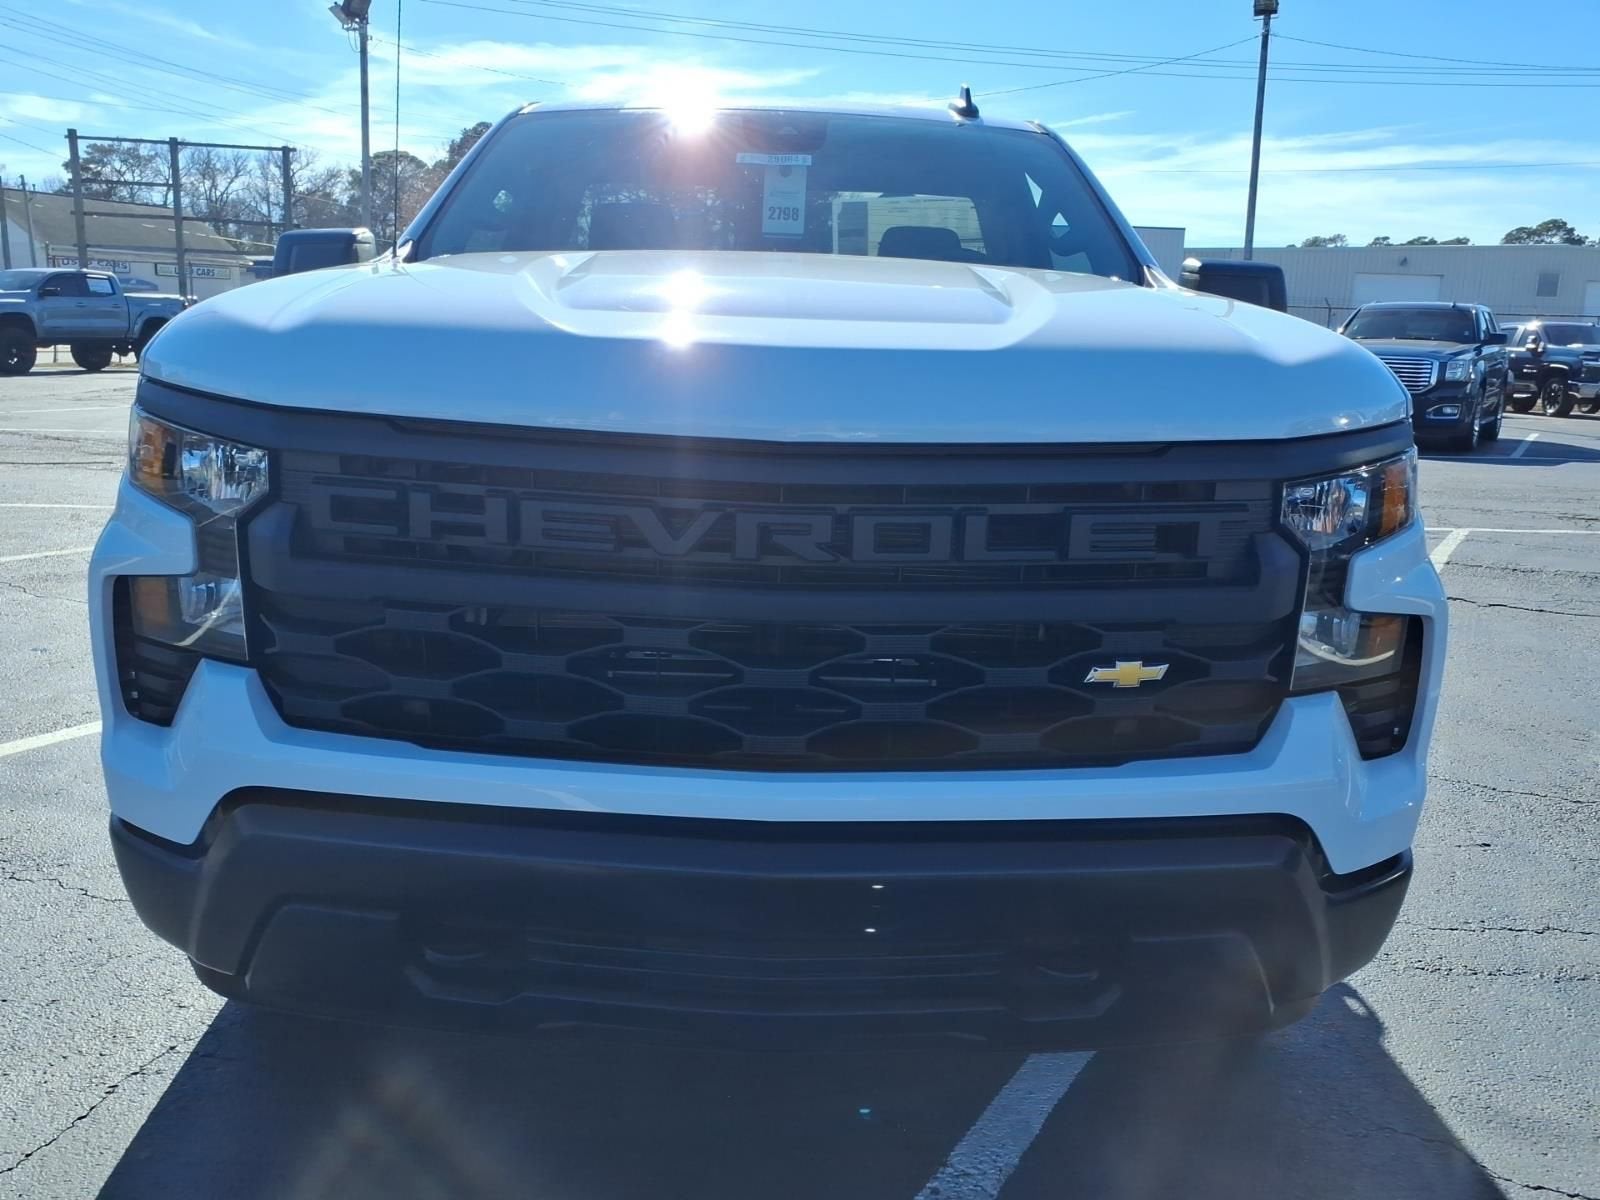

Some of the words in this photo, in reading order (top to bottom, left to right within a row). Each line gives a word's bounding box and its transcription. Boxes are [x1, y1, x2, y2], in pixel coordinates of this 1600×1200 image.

[767, 206, 800, 221] 2798
[61, 258, 92, 266] USD
[196, 268, 215, 277] CARS
[310, 480, 1250, 562] CHEVROLET
